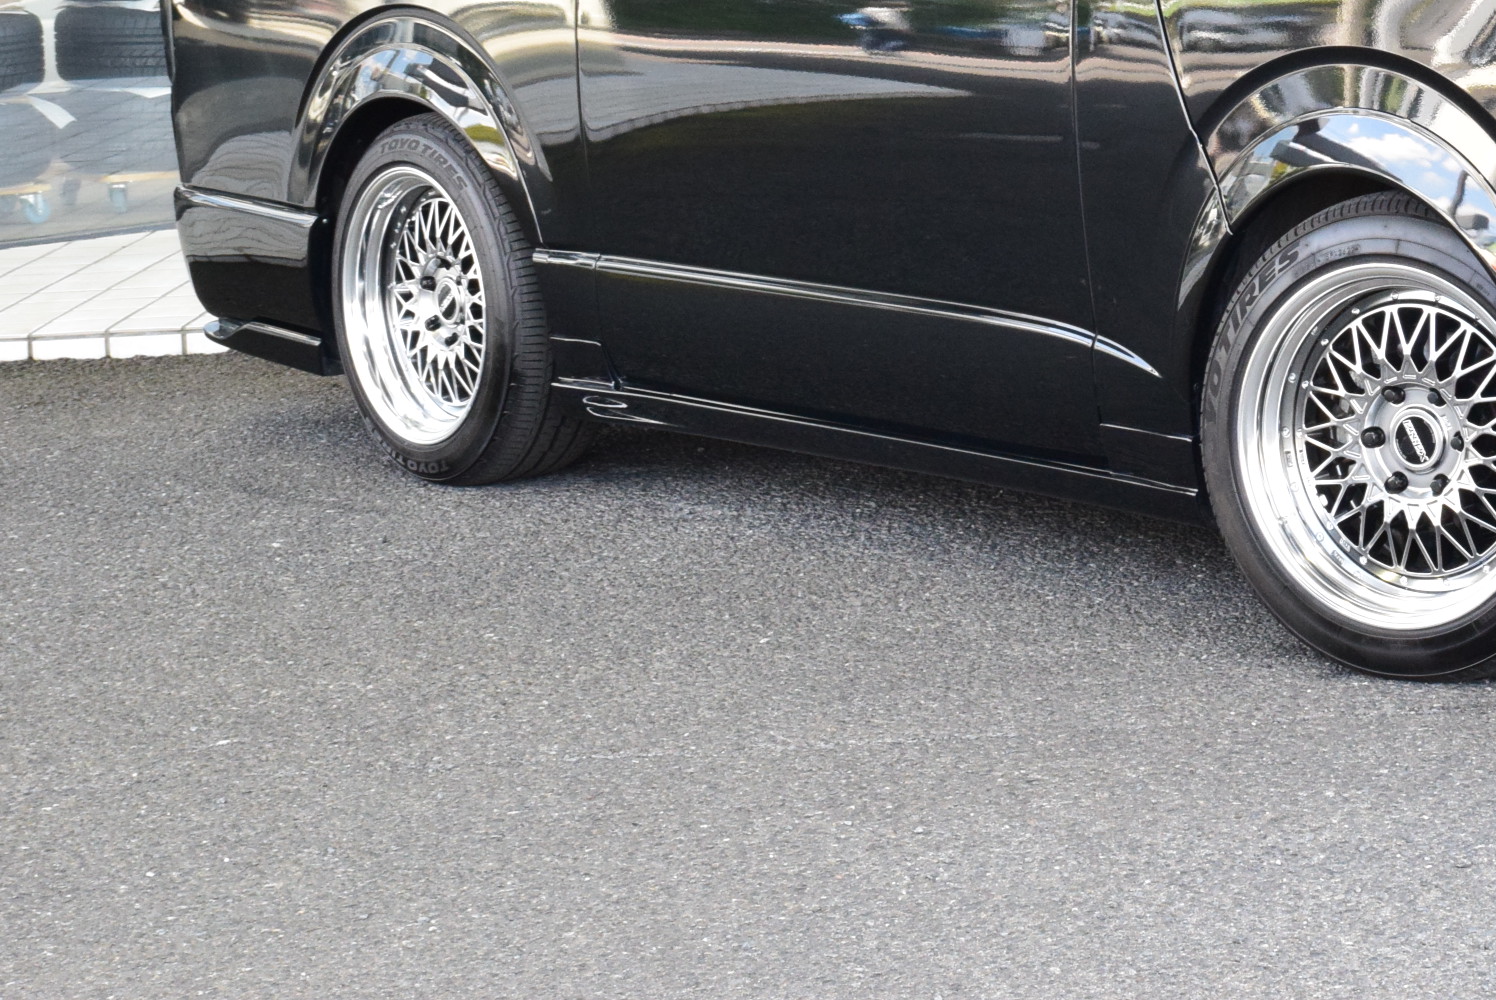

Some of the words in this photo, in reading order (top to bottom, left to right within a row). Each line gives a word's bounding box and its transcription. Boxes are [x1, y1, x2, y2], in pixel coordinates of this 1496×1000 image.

[380, 138, 421, 154] TOYO
[421, 144, 468, 190] TIRES
[1218, 241, 1300, 356] TIRES
[407, 460, 448, 474] TOYO
